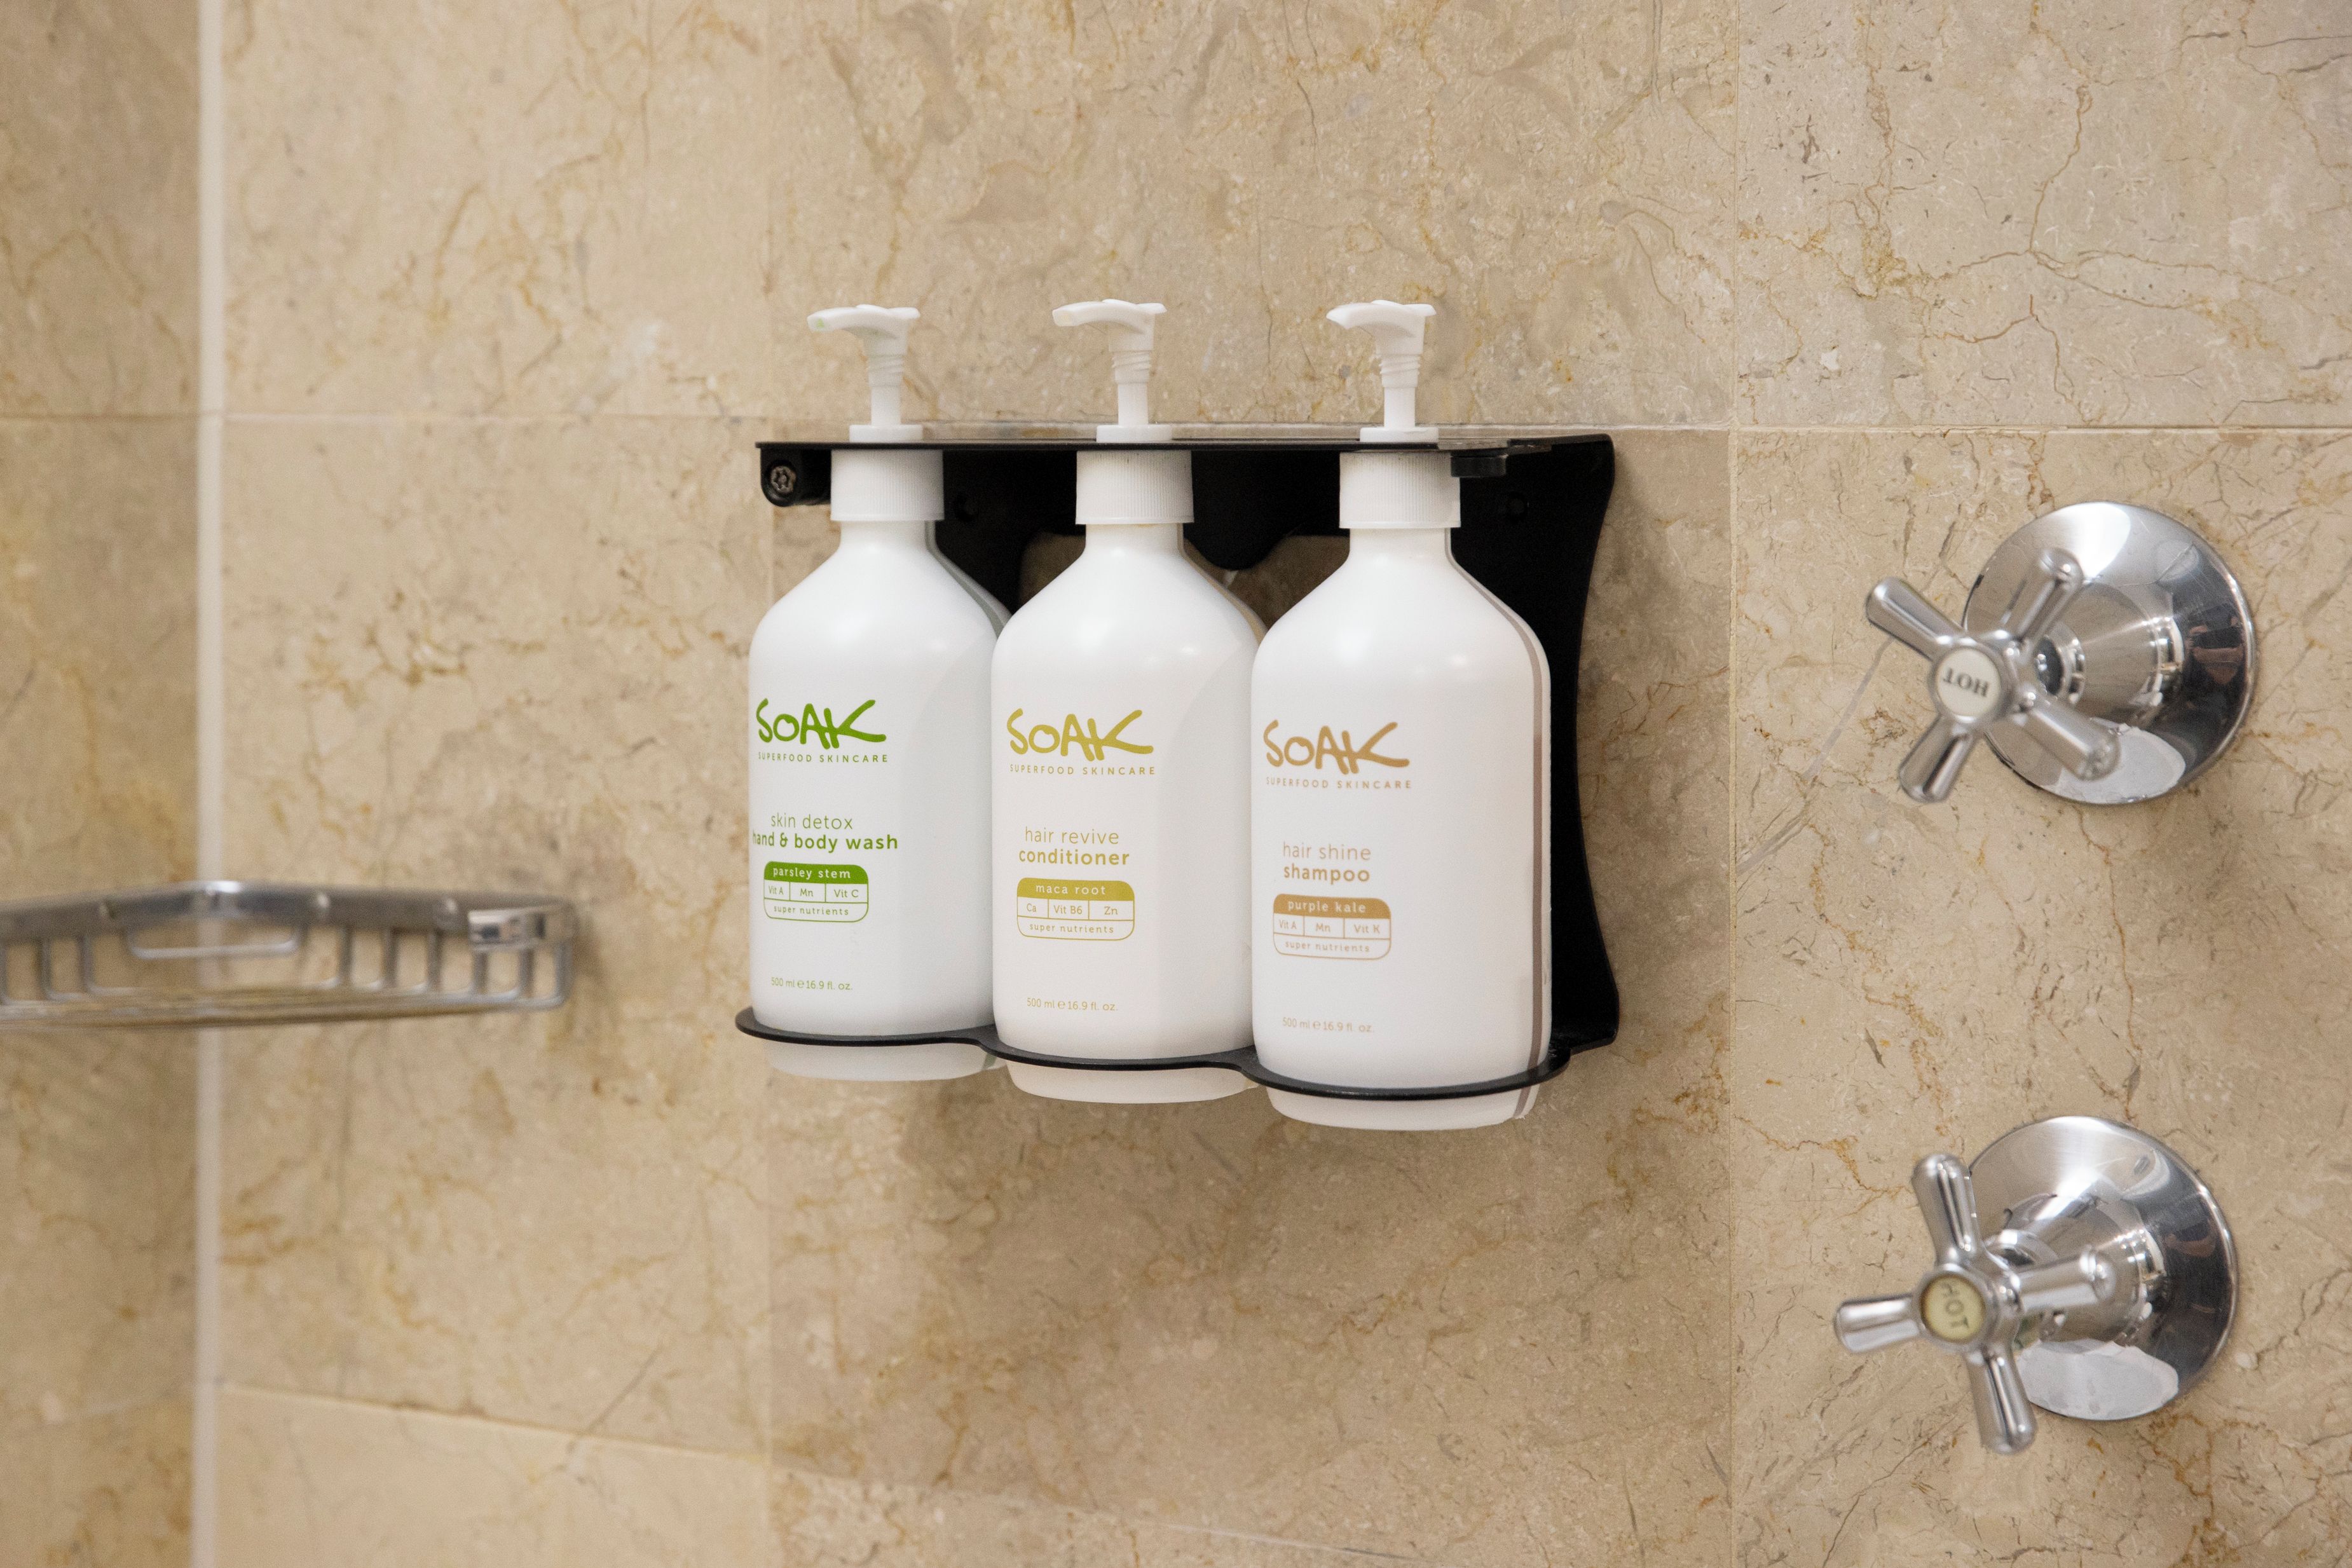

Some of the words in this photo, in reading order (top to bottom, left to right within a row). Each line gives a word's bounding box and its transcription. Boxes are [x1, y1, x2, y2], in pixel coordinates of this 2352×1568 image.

[1943, 667, 1989, 697] HOT
[758, 752, 812, 762] SUPERFOOD
[819, 754, 887, 763] SKINCARE
[1010, 764, 1074, 775] SUPERFOOD
[1083, 767, 1155, 775] SKINCARE
[1266, 777, 1329, 787] SUPERFOOD
[1337, 780, 1411, 789] SKINCARE
[771, 812, 796, 828] skin
[802, 814, 853, 829] detox
[1025, 826, 1054, 843] hair
[1062, 828, 1119, 845] revive
[753, 829, 774, 847] hand
[780, 833, 788, 847] &
[795, 833, 838, 853] body
[845, 834, 898, 849] wash
[1283, 842, 1311, 857] hair
[1319, 843, 1371, 861] shine
[1019, 849, 1130, 865] conditioner
[773, 866, 812, 880] parsley
[818, 869, 851, 878] stem
[1284, 862, 1370, 885] shampoo
[768, 885, 777, 894] Vit
[778, 887, 783, 895] A
[800, 888, 814, 897] Mn
[834, 889, 847, 897] Vit
[1036, 884, 1068, 894] maca
[1075, 885, 1105, 895] root
[774, 905, 795, 914] super
[800, 906, 849, 915] nutrients
[1027, 903, 1037, 912] Ca
[1053, 905, 1067, 914] Vit
[1070, 906, 1083, 914] B6
[1104, 906, 1118, 915] Zn
[1288, 900, 1329, 913] purple
[1336, 902, 1366, 913] kale
[1030, 923, 1055, 932] super
[1060, 925, 1114, 933] nutrients
[1279, 920, 1289, 929] Vit
[1291, 921, 1297, 929] A
[1316, 923, 1331, 932] Mn
[1354, 924, 1369, 932] Vit
[1373, 925, 1380, 933] K
[1285, 941, 1310, 949] super
[1316, 943, 1370, 951] nutrients
[770, 977, 783, 986] 500
[1027, 998, 1041, 1007] 500
[1282, 1017, 1297, 1027] 500
